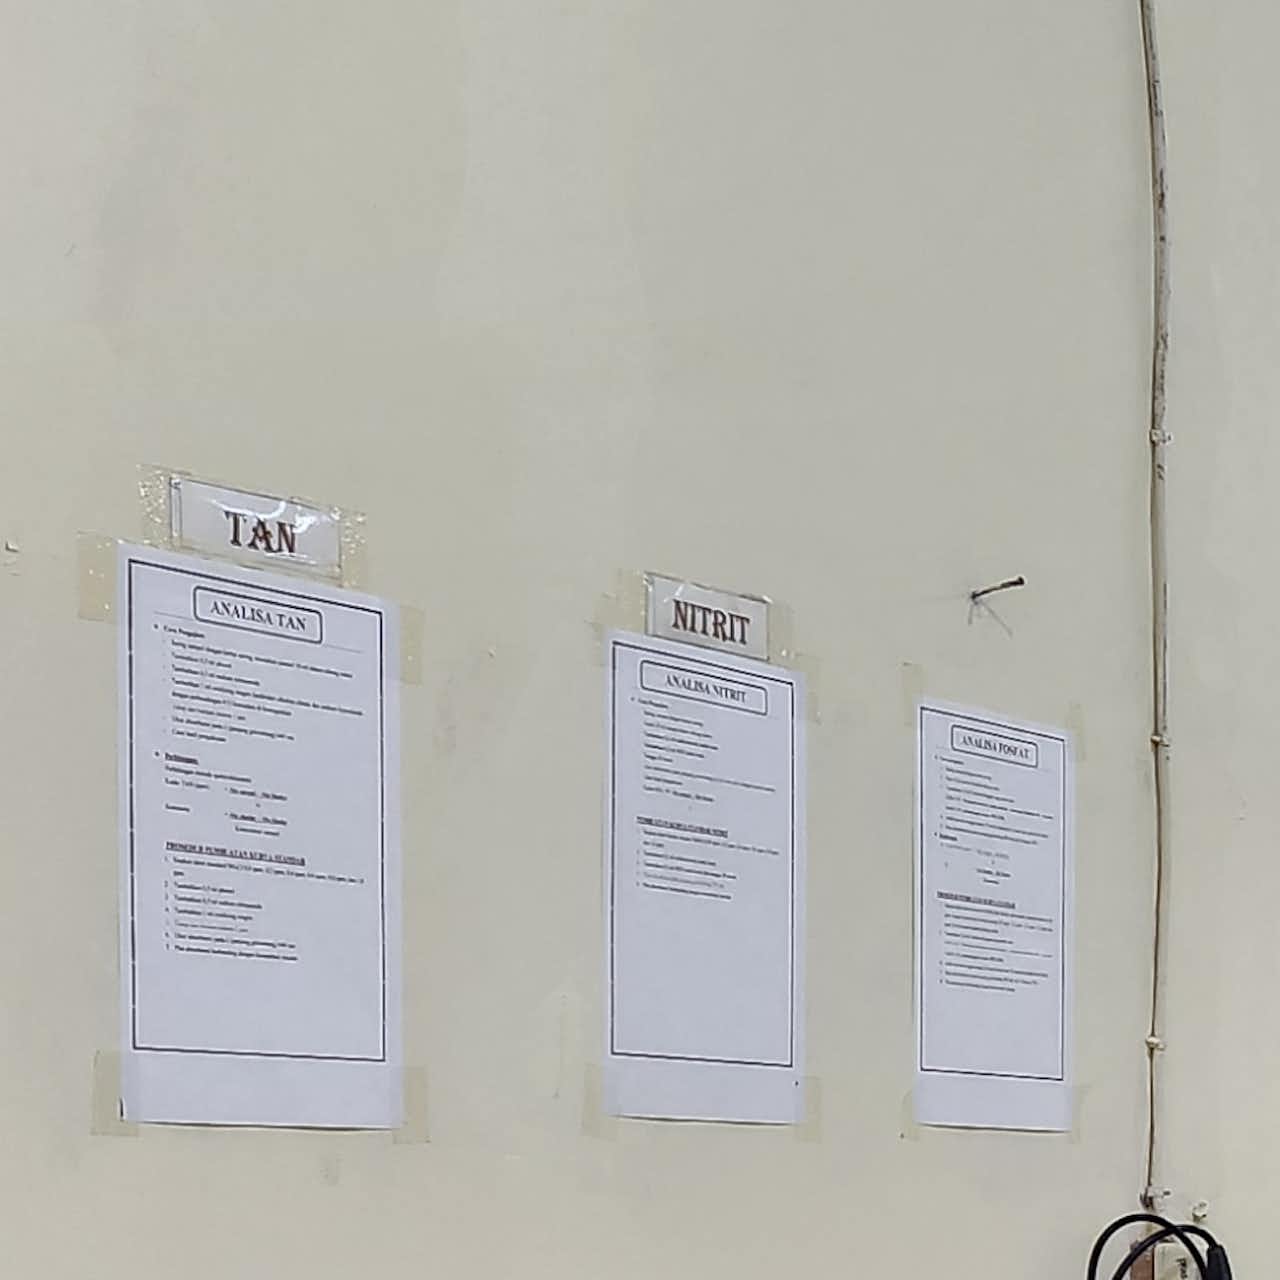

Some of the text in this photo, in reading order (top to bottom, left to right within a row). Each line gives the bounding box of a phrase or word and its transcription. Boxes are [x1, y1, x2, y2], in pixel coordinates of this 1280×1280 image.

[223, 510, 297, 556] TAN
[210, 600, 307, 631] ANALISA TAN
[672, 599, 750, 645] NITRIT
[666, 674, 746, 703] ANALISA NITRIT
